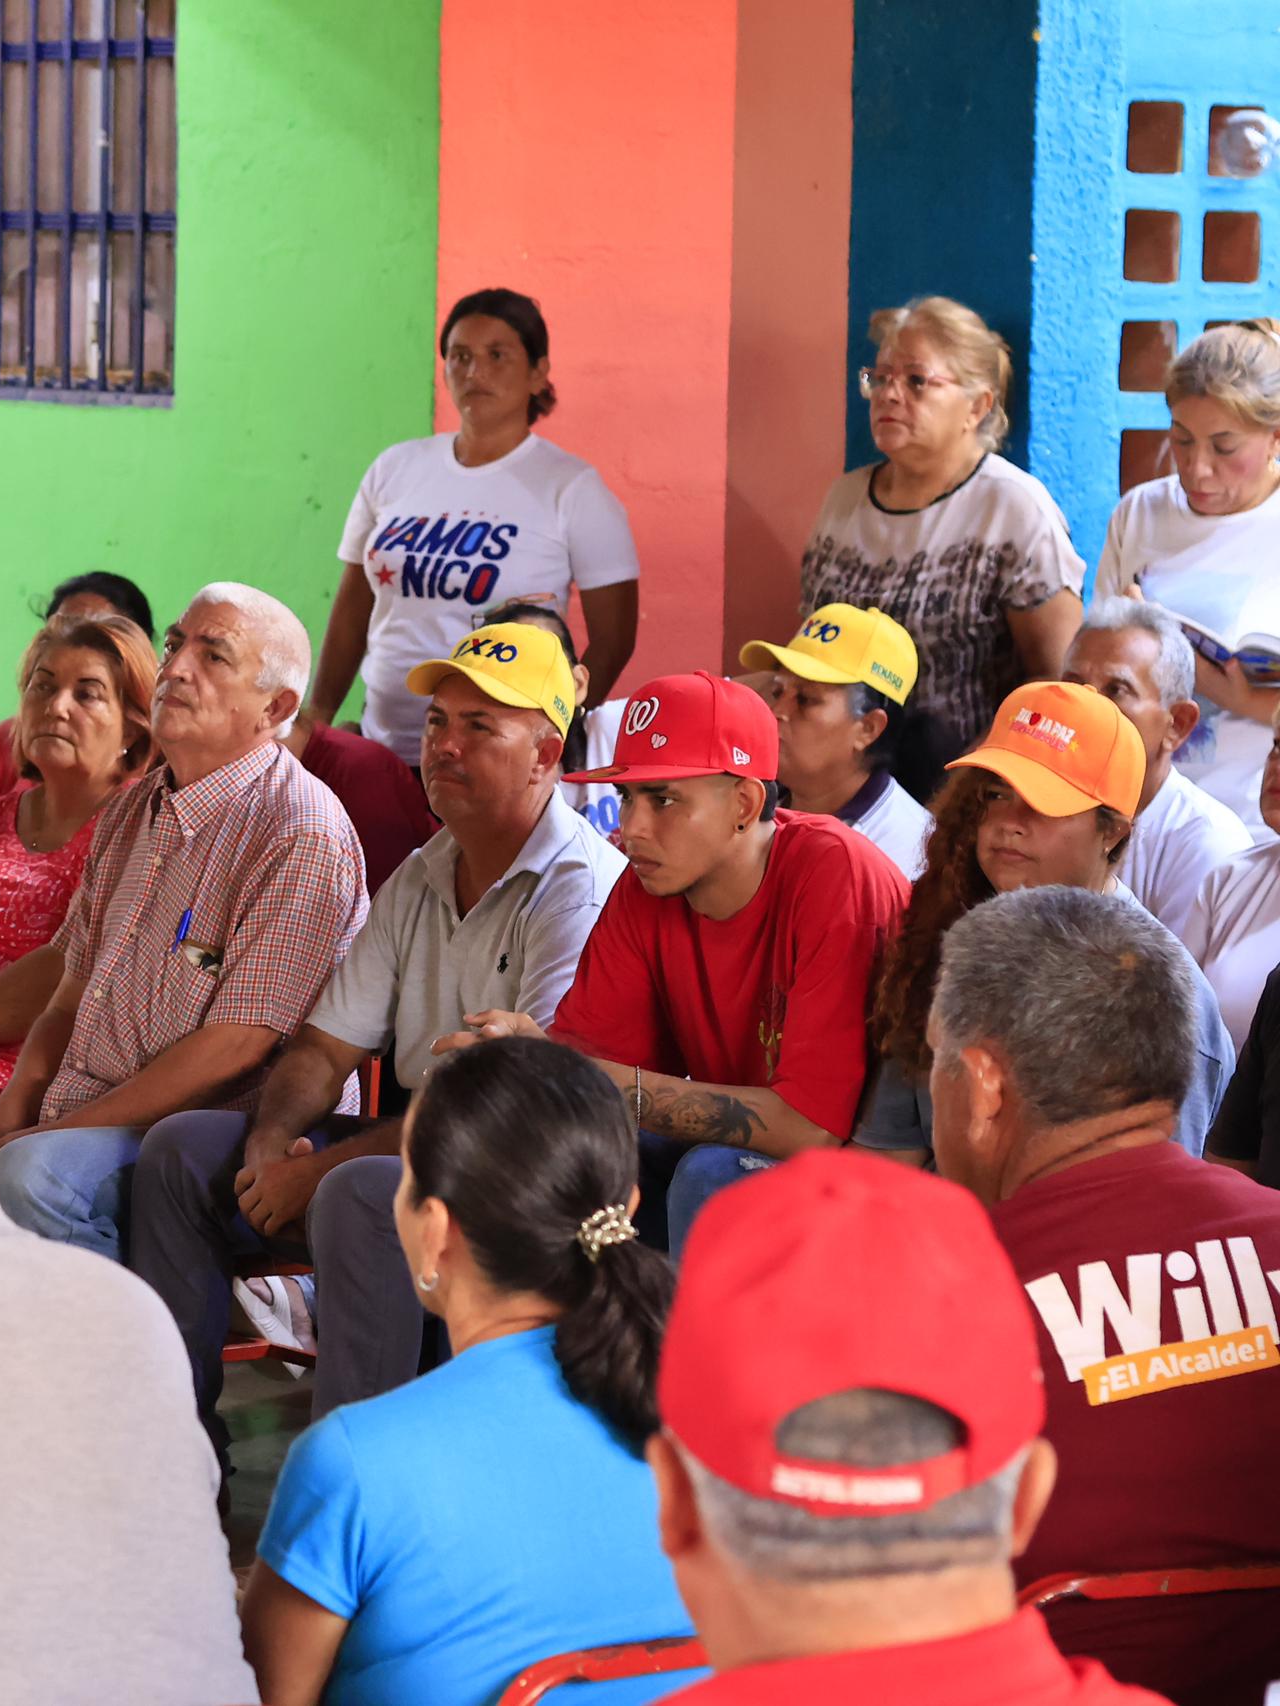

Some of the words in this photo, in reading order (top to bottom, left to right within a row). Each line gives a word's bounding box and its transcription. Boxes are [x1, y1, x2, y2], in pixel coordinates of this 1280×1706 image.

[372, 516, 518, 560] VAMOS
[402, 555, 500, 605] NICO
[625, 697, 659, 735] W
[1099, 1361, 1141, 1403] ¡El
[1147, 1334, 1268, 1383] Alcalde!
